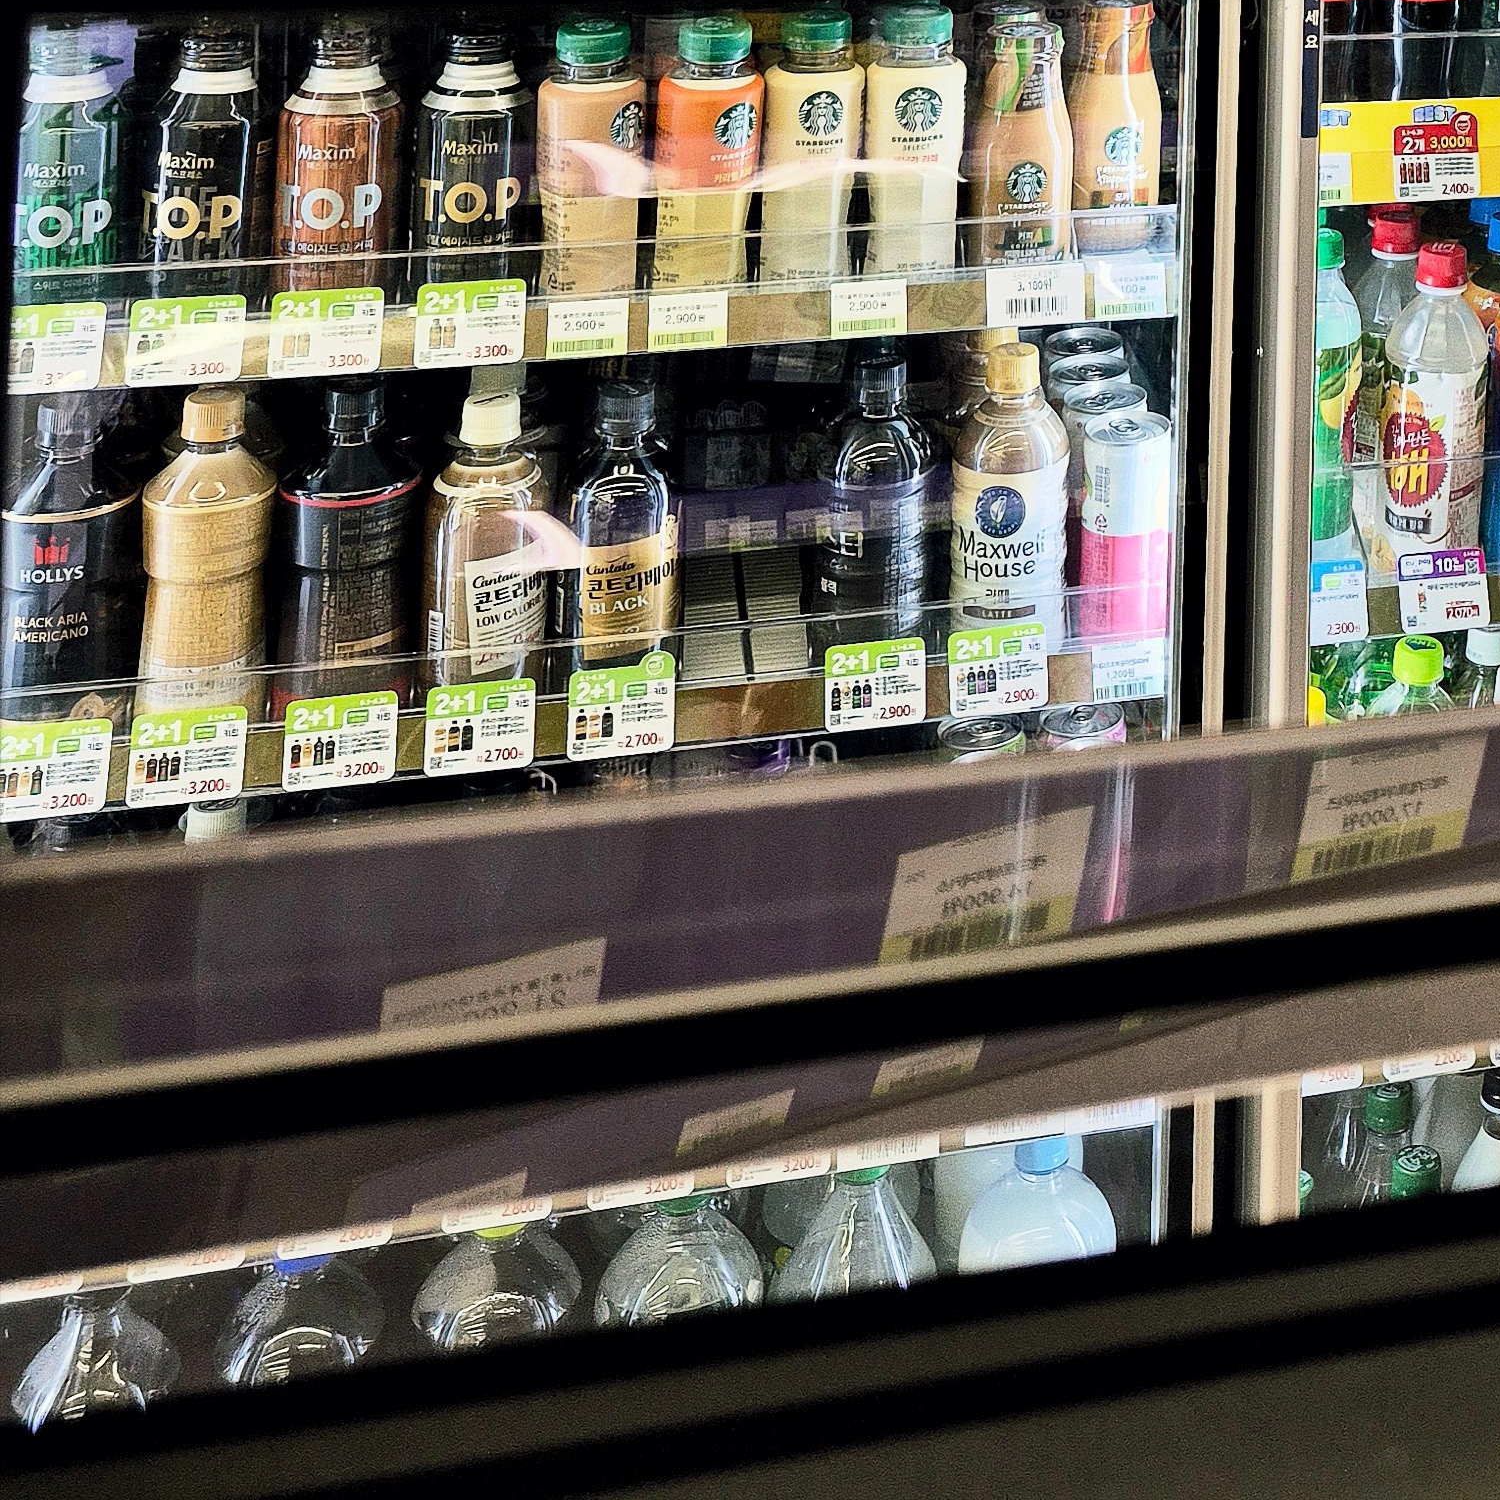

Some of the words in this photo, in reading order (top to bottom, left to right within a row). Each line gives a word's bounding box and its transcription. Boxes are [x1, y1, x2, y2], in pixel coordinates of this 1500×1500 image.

[1413, 106, 1456, 122] BEST
[795, 138, 843, 147] STARBUCKS
[891, 134, 943, 143] STARBUCKS
[902, 143, 930, 151] SELECT
[1402, 137, 1425, 152] 2개
[1430, 134, 1474, 150] 3,000원
[298, 144, 356, 161] Maxim
[441, 140, 498, 156] Maxim
[807, 147, 832, 155] SELECT
[158, 152, 215, 170] Maxim
[24, 161, 87, 179] Maxim
[1441, 183, 1474, 194] 2,400원
[280, 183, 382, 230] T.O.P
[420, 177, 521, 224] T.O.P
[14, 199, 112, 249] T.O.P
[142, 195, 242, 240] T.O.P
[279, 299, 321, 319] 2+1
[425, 290, 466, 312] 2+1
[849, 300, 887, 311] 2,900원
[140, 305, 183, 327] 2+1
[665, 313, 705, 324] 2,900원
[564, 320, 605, 331] 2,900원
[474, 345, 514, 357] 3,300원
[958, 527, 1046, 560] Maxwell
[19, 566, 84, 584] HOLLYS
[586, 561, 635, 576] Cantata
[964, 558, 1036, 582] House
[588, 595, 649, 616] BLACK
[982, 608, 1014, 619] LATTE
[14, 616, 52, 629] BLACK
[57, 612, 88, 626] ARIA
[476, 614, 501, 628] LOW
[1326, 623, 1361, 635] 2,300원
[11, 625, 89, 643] AMERICANO
[956, 637, 993, 660] 2+1
[832, 651, 870, 674] 2+1
[576, 680, 616, 704] 2+1
[1004, 689, 1040, 704] 2,900원
[435, 691, 476, 715] 2+1
[293, 705, 335, 730] 2+1
[879, 705, 916, 719] 2,900원
[138, 720, 182, 744] 2+1
[1, 733, 45, 757] 2+1
[625, 735, 664, 749] 2,700원
[484, 747, 524, 763] 2,700원
[344, 763, 384, 777] 3,200원
[189, 780, 231, 795] 3,200원
[50, 794, 94, 809] 3,200원
